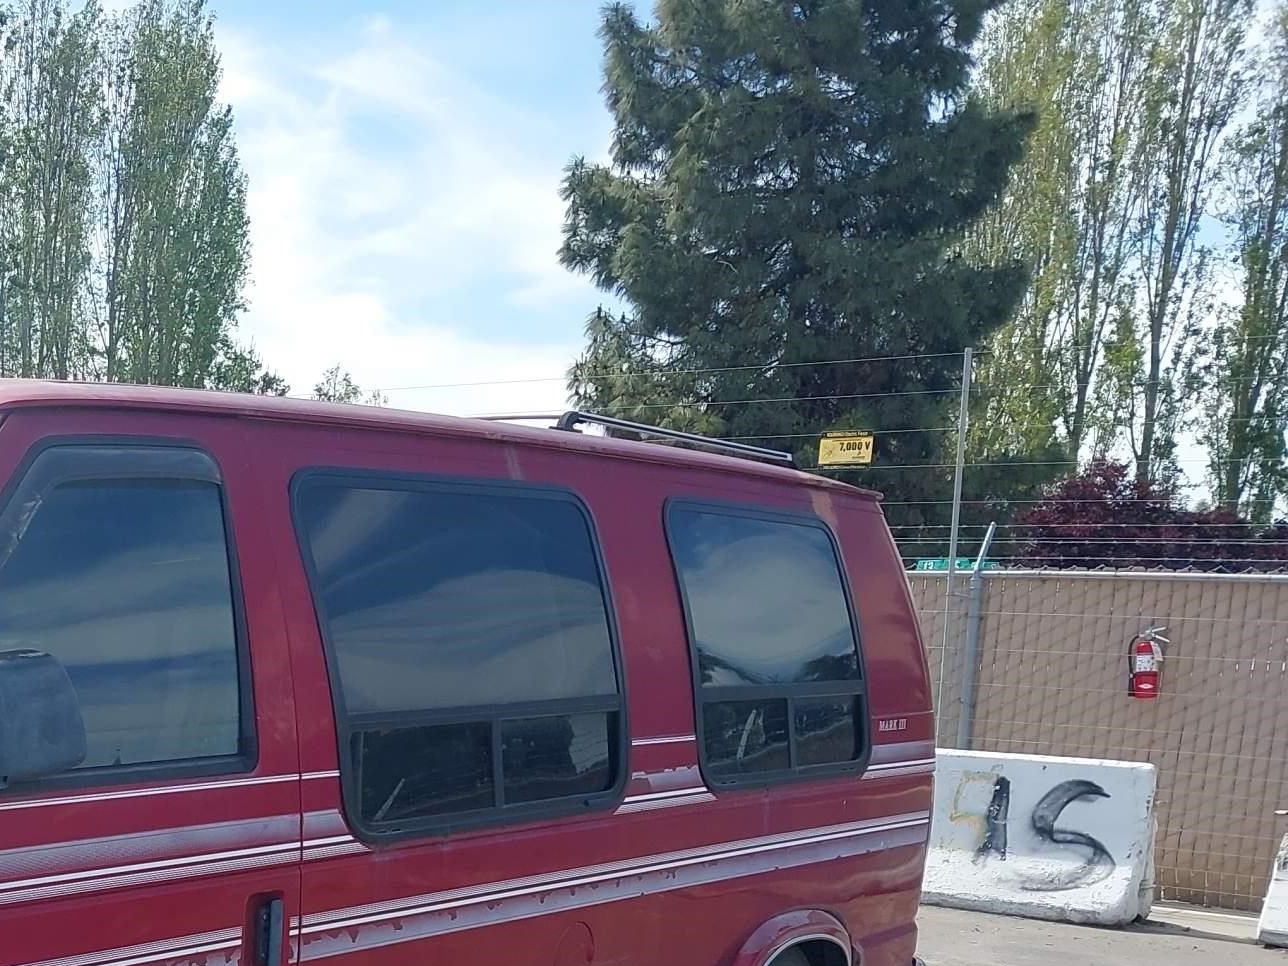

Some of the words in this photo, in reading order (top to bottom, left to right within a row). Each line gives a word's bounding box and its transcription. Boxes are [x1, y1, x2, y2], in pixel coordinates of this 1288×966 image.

[839, 441, 863, 452] 7,000
[864, 441, 871, 451] V
[879, 719, 898, 731] MARK
